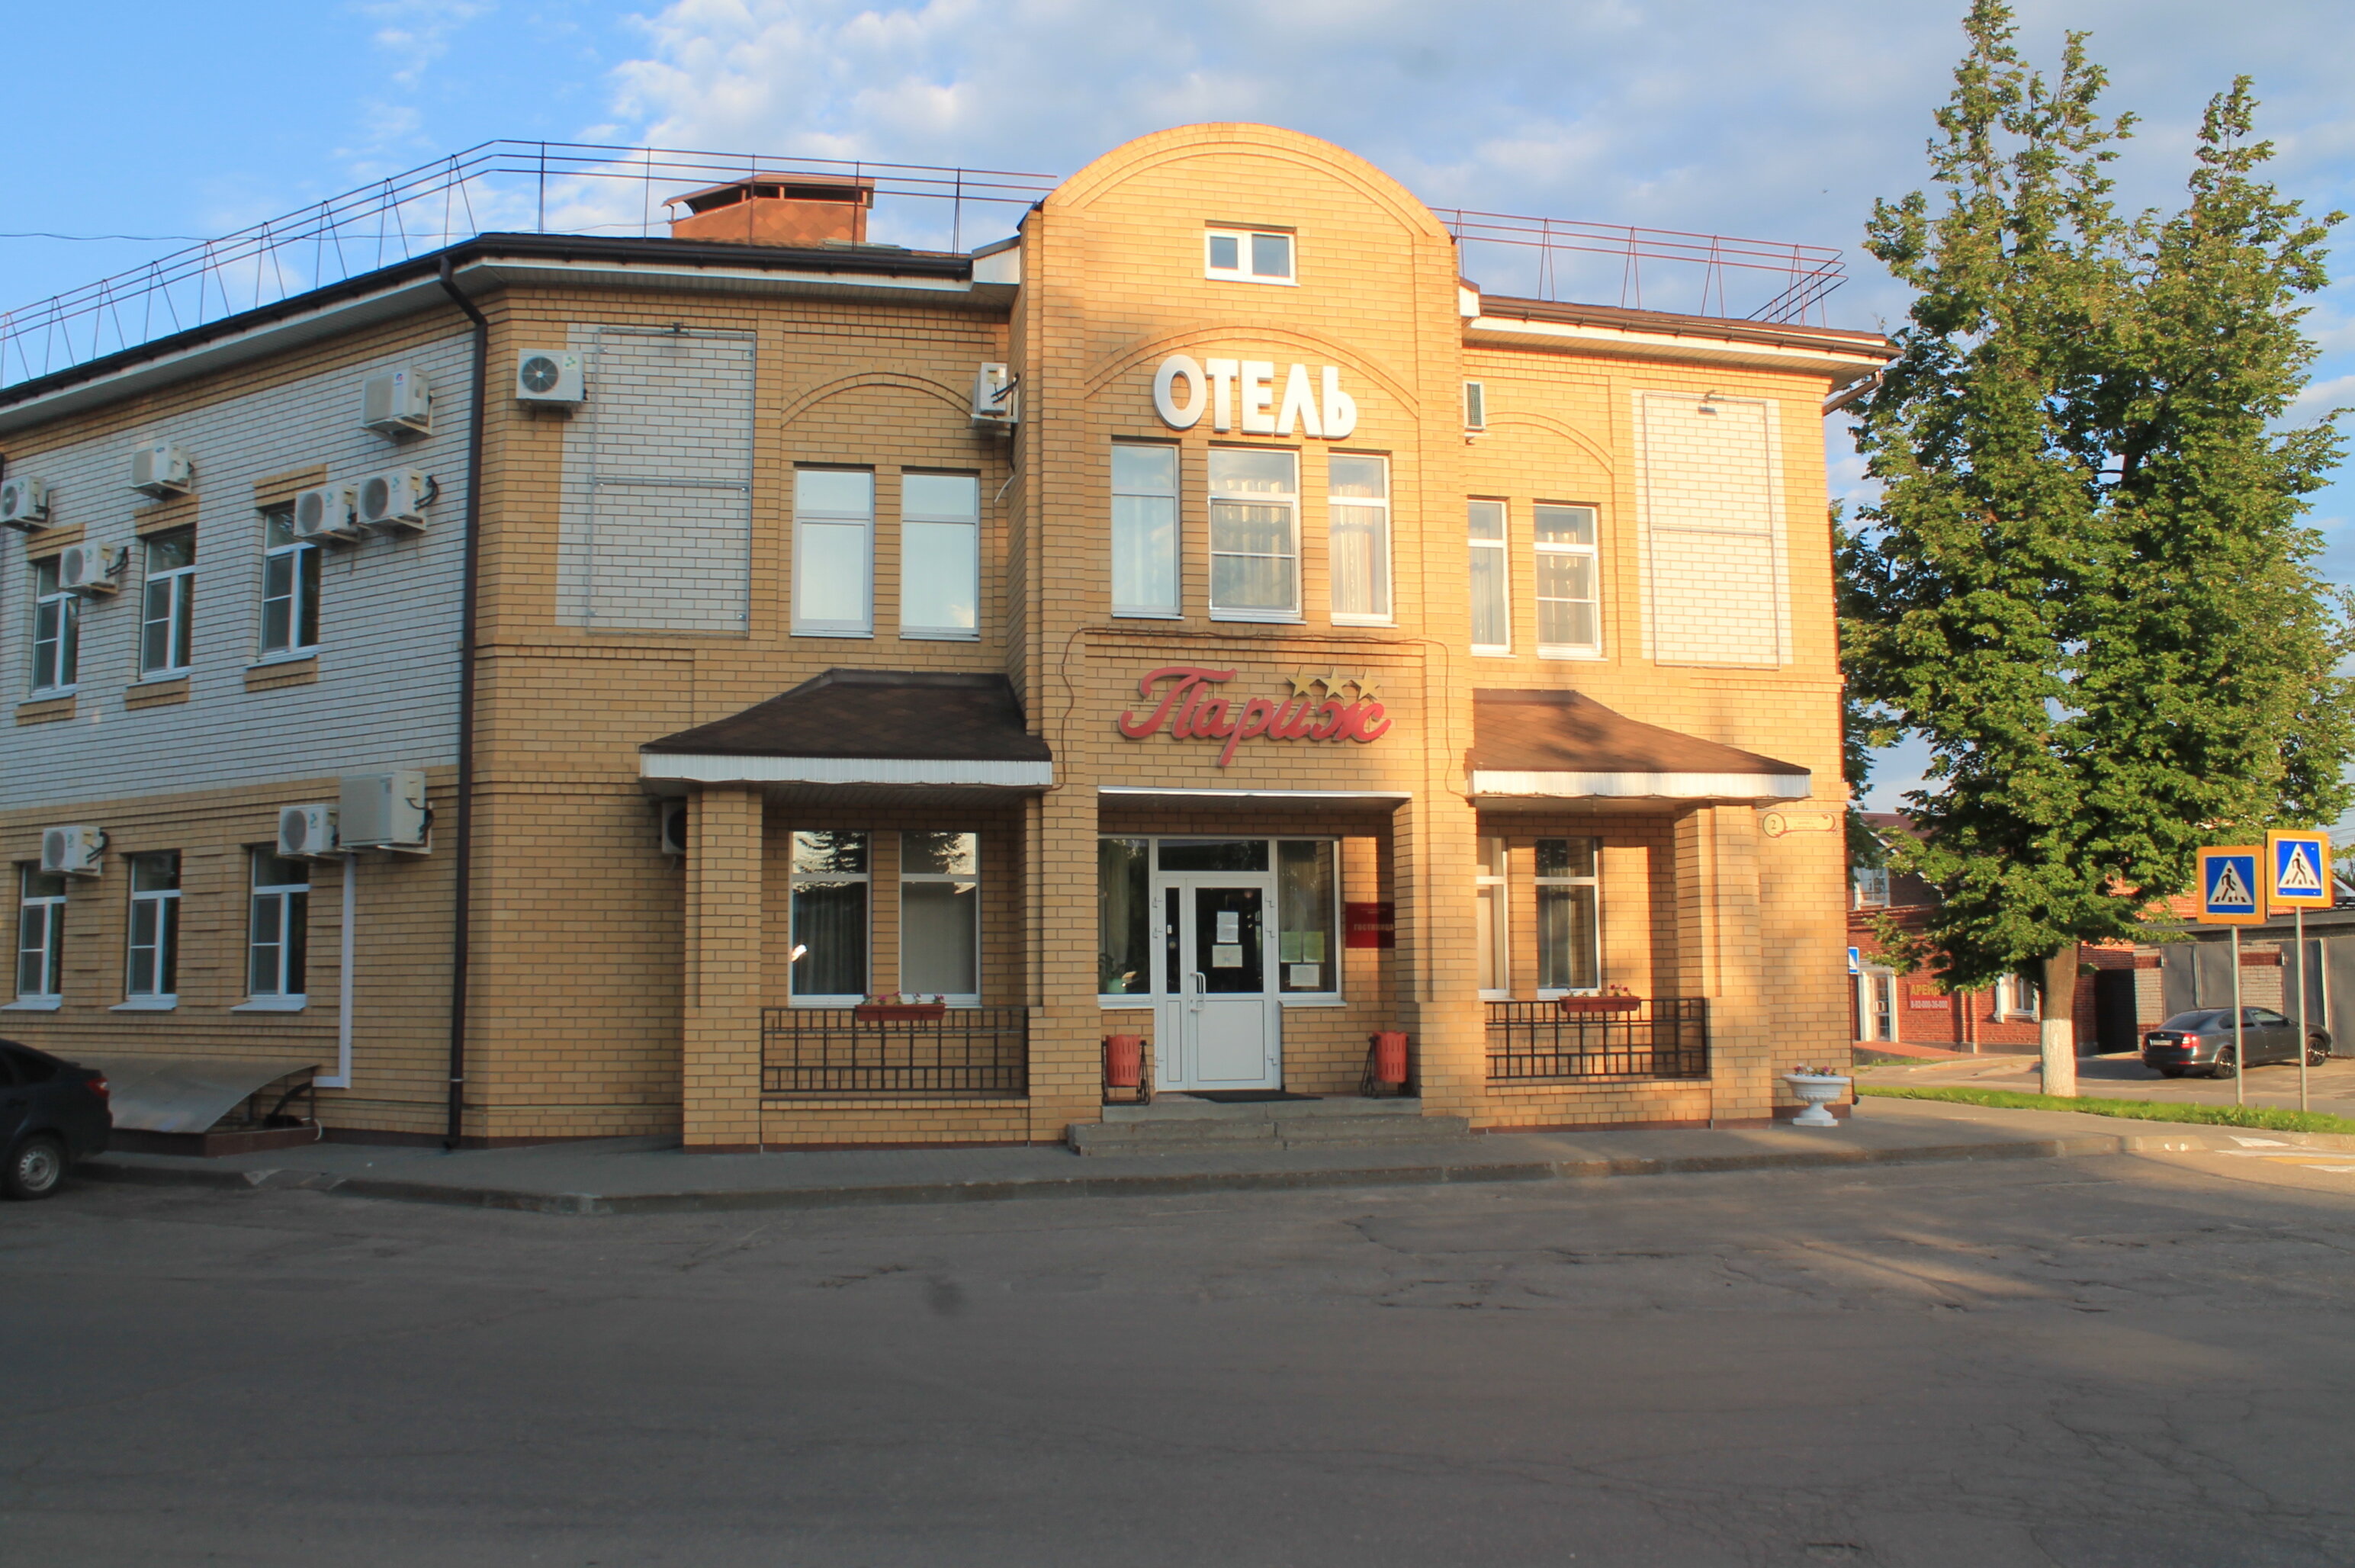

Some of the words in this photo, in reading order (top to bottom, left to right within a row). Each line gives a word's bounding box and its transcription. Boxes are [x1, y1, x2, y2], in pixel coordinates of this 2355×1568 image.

[1153, 355, 1357, 440] ОТЕЛЬ
[1119, 666, 1392, 767] Париж
[1771, 819, 1776, 830] 2
[1910, 984, 1942, 997] АРЕНД
